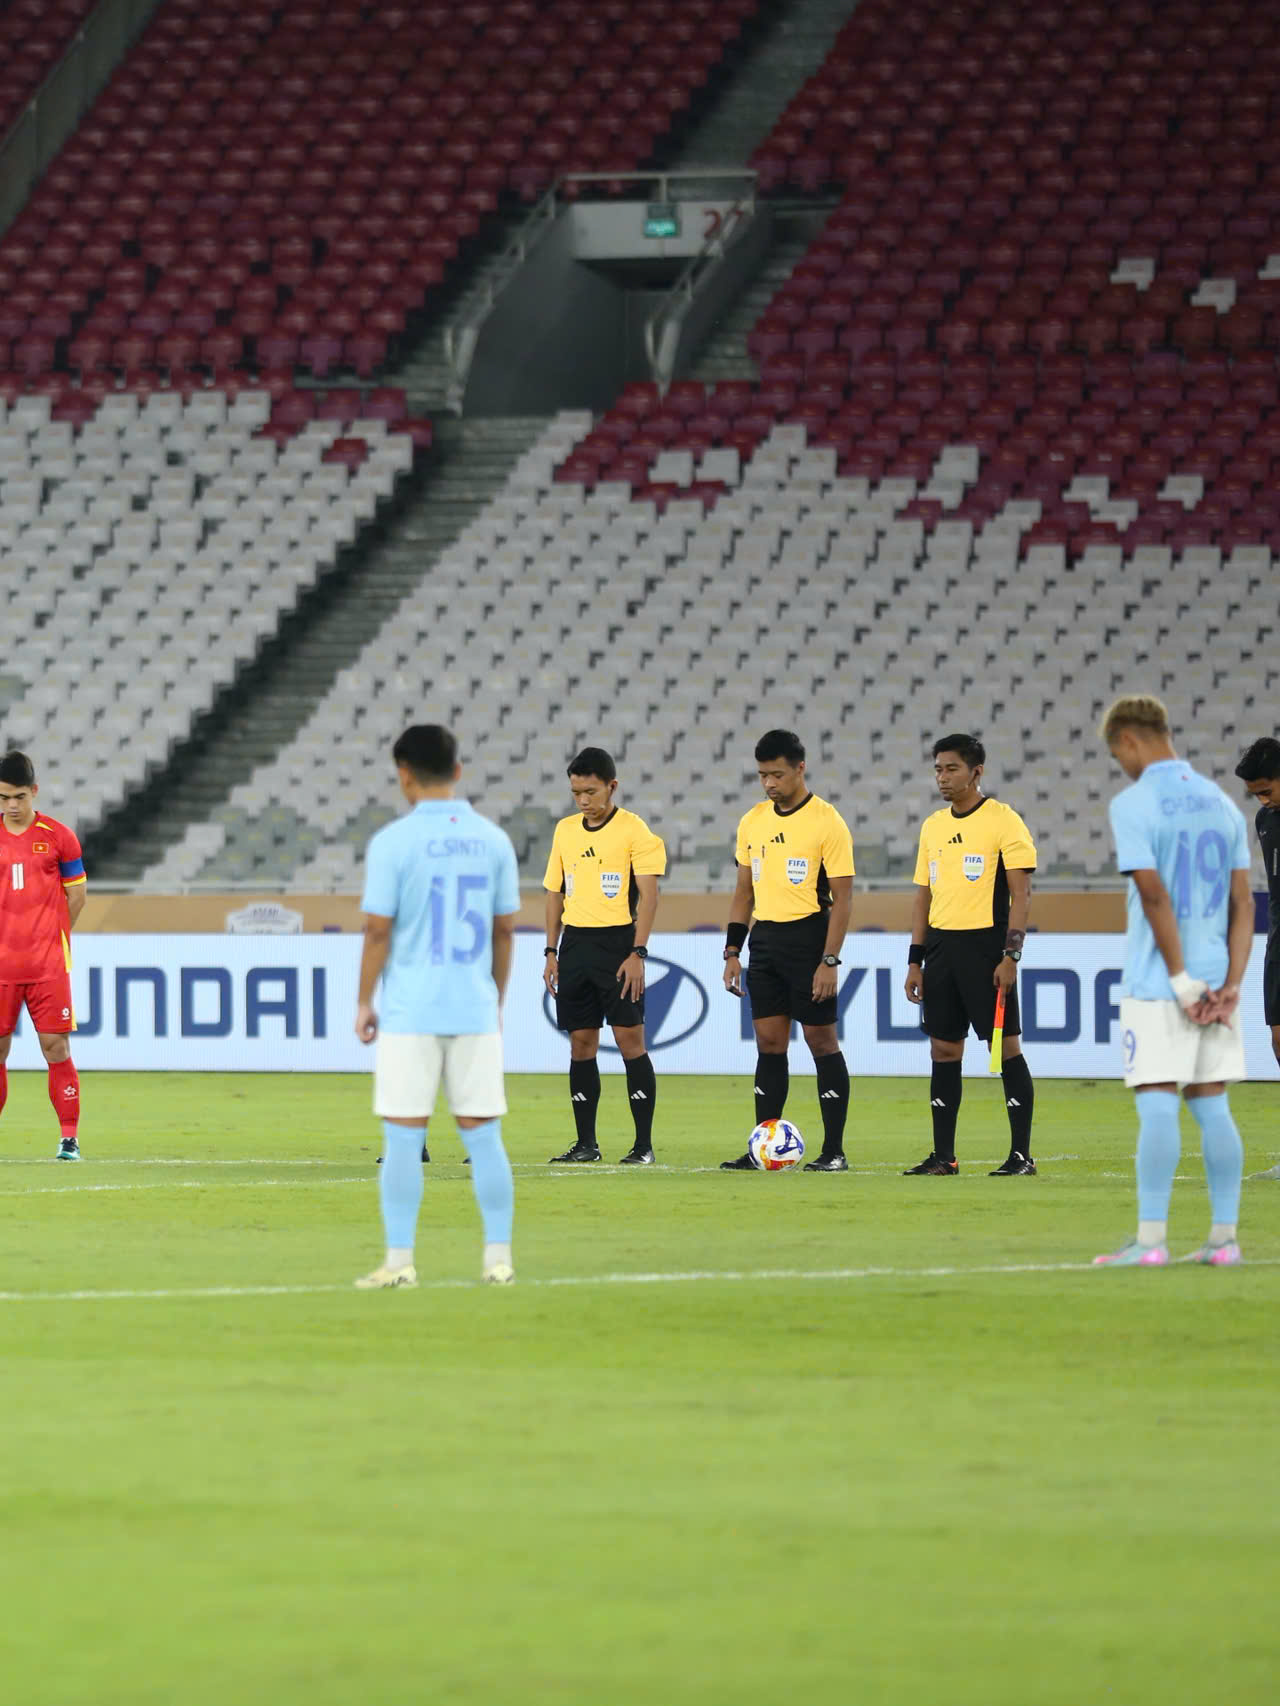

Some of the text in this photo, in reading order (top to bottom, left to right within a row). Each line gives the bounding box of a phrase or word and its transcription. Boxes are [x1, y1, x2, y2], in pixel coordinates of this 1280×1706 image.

[12, 863, 24, 890] 11
[788, 859, 806, 867] FIFA
[1177, 830, 1228, 919] 19
[431, 874, 488, 965] 15
